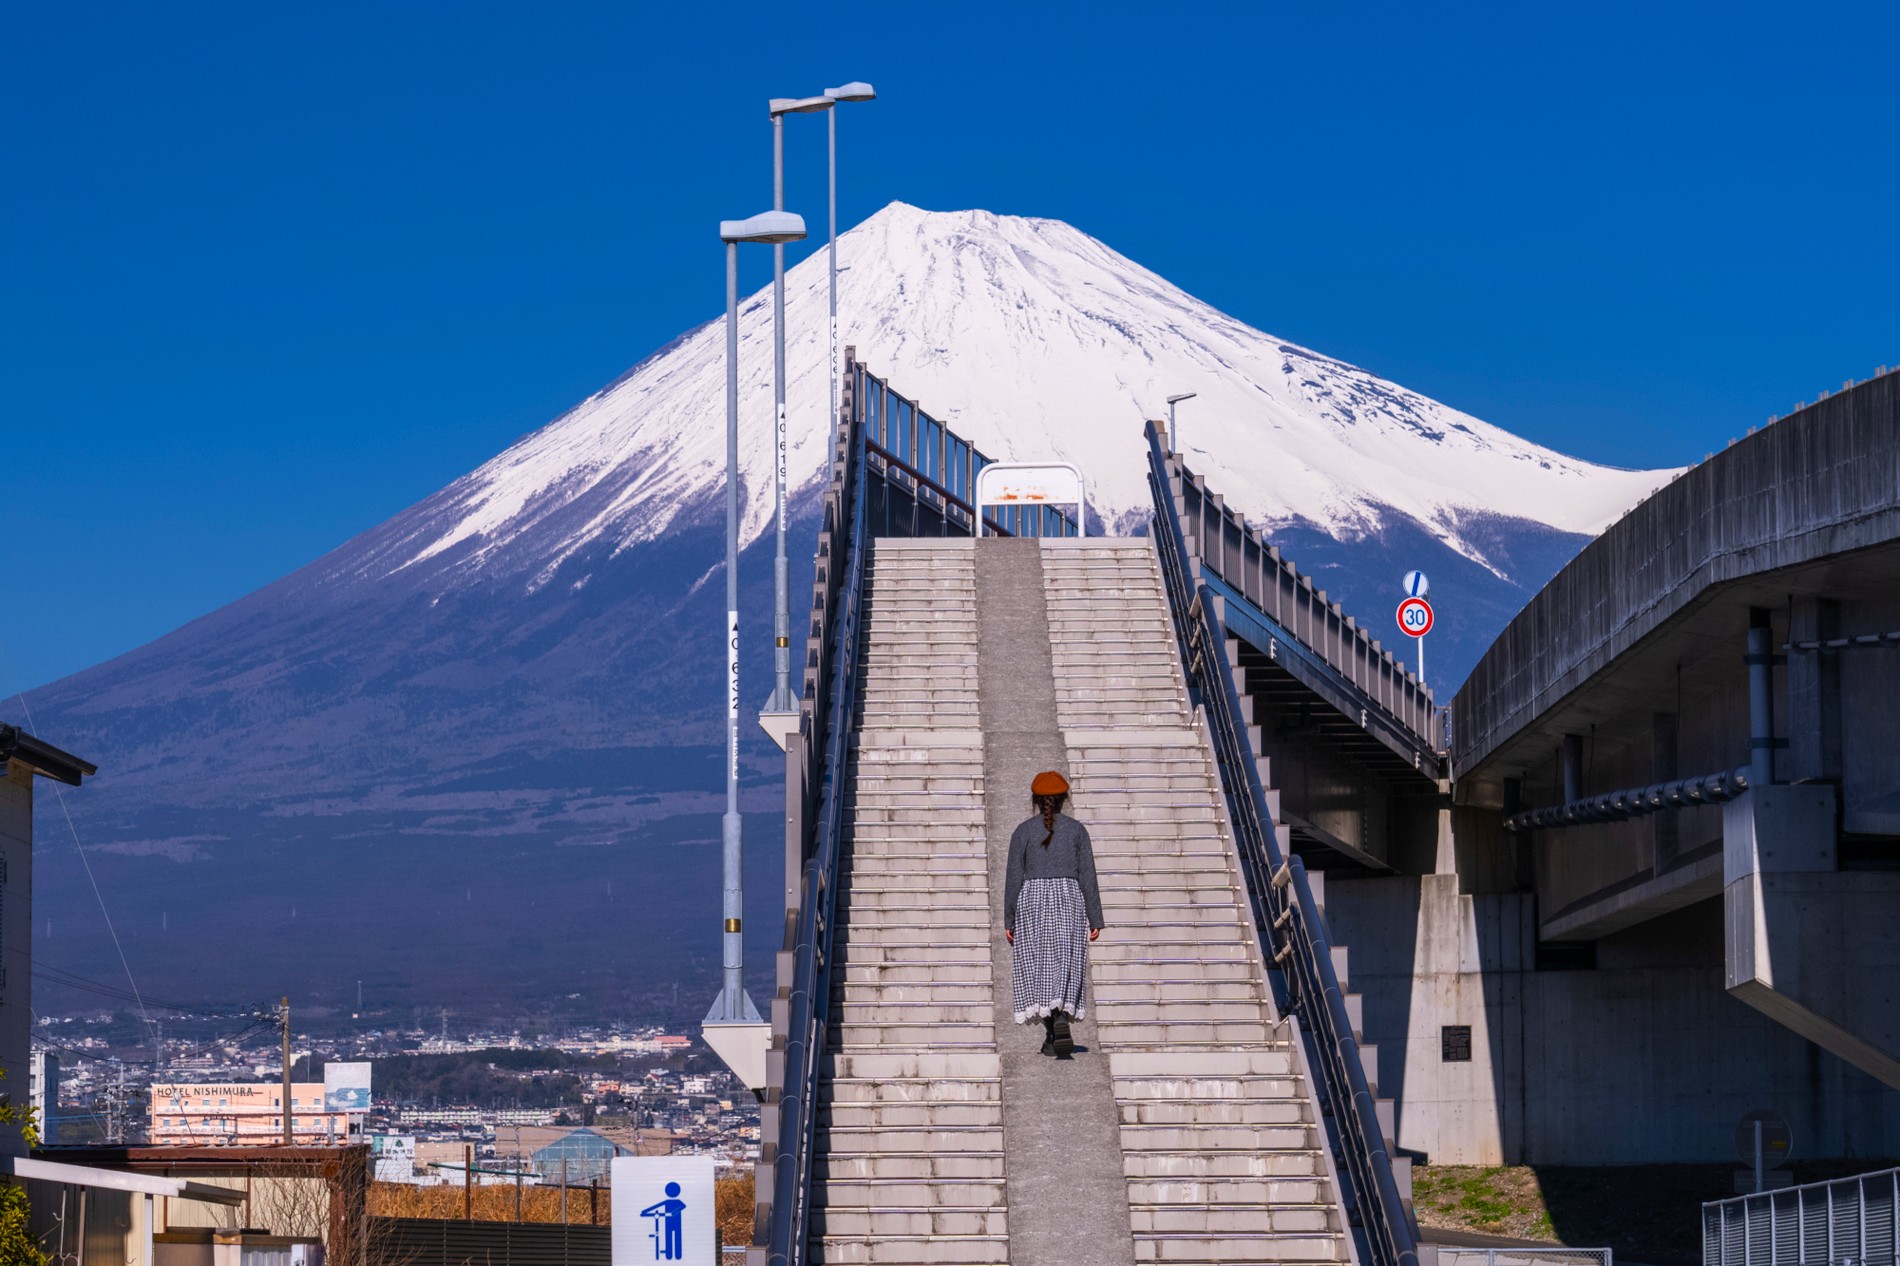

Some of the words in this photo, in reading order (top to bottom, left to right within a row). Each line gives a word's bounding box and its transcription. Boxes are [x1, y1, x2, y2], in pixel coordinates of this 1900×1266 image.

[1405, 609, 1425, 626] 30
[157, 1087, 191, 1096] HOTEL
[193, 1087, 254, 1097] NISHIMURA
